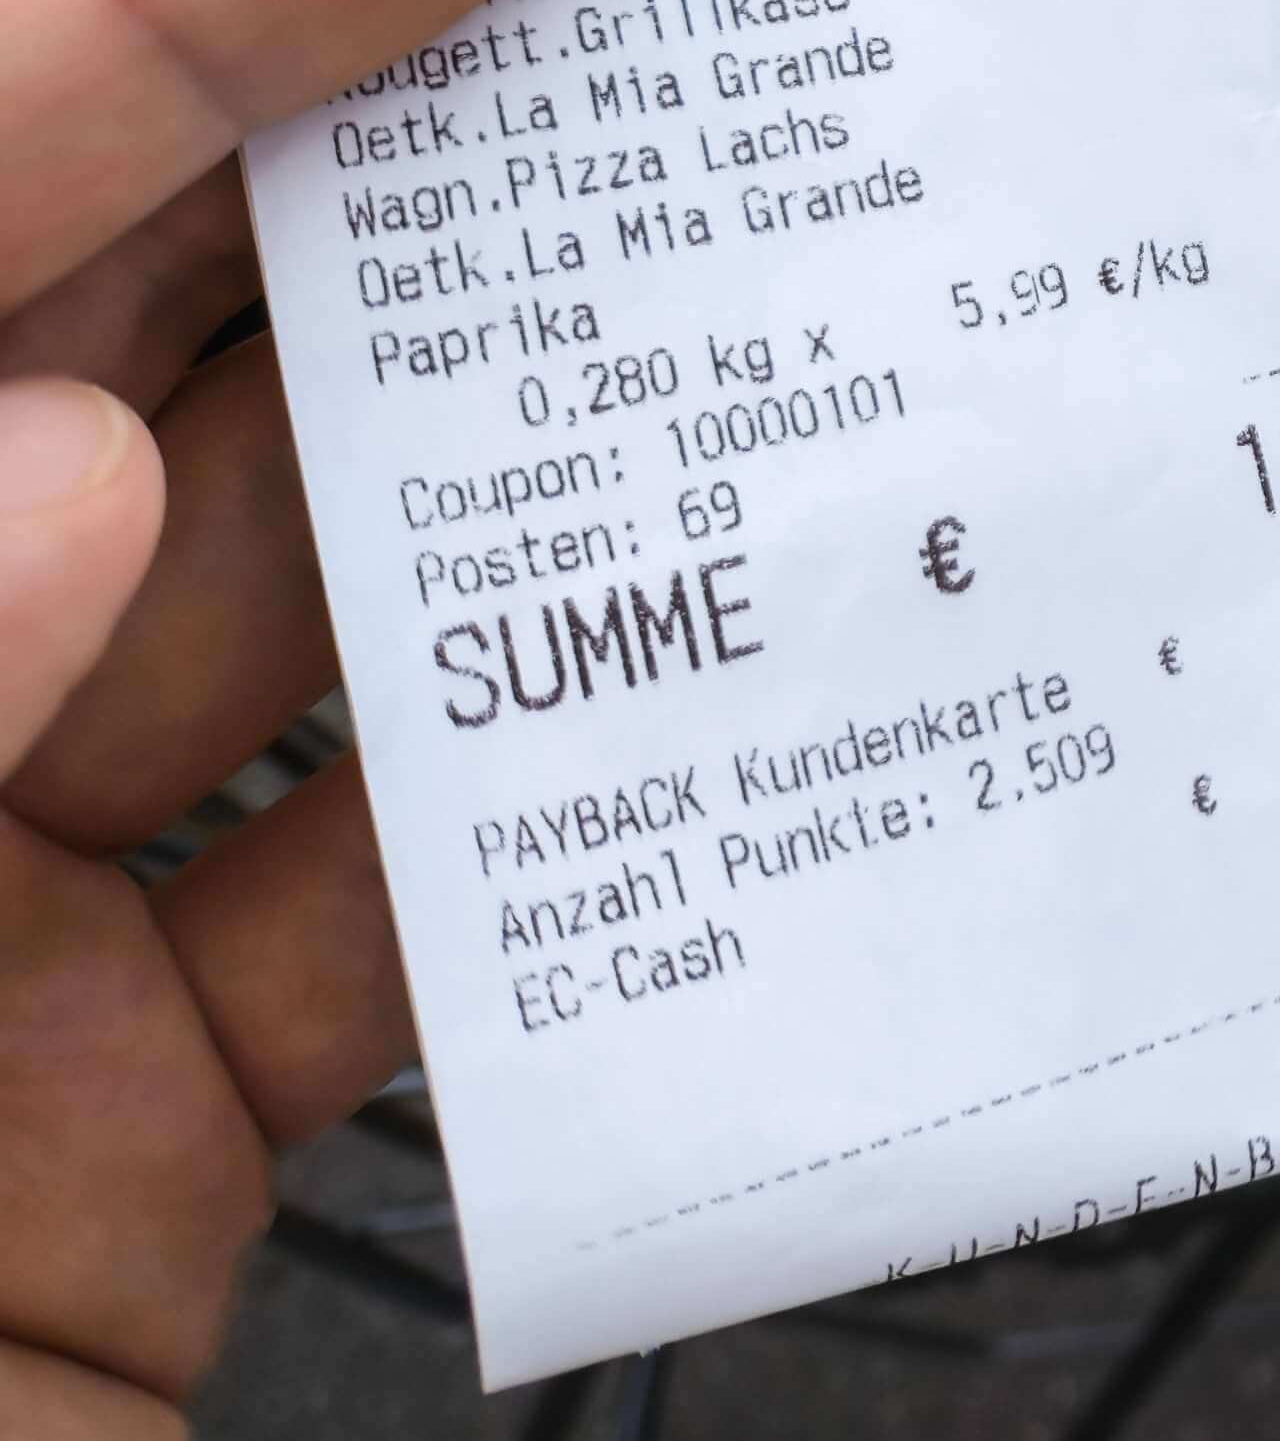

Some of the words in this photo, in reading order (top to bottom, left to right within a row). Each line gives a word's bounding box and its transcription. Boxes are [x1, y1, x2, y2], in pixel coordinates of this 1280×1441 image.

[333, 92, 559, 169] Oetk.La
[587, 66, 685, 123] Mia
[712, 27, 894, 100] Grande
[343, 145, 668, 240] Wagn.Pizza
[699, 109, 850, 172] Lachs
[357, 228, 585, 310] Oetk.La
[615, 202, 713, 260] Mia
[741, 158, 924, 235] Grande
[370, 298, 601, 386] Paprika
[518, 347, 679, 427] 0,280
[707, 334, 775, 387] kg
[951, 263, 1068, 329] 5,99
[1097, 239, 1209, 299] €/kg
[400, 447, 624, 531] Coupon:
[666, 368, 905, 468] 10000101
[415, 520, 640, 607] Posten:
[677, 480, 742, 541] 69
[433, 554, 765, 730] SUMME
[918, 515, 976, 596] €
[473, 765, 707, 878] PAYBACK
[734, 672, 1071, 806] Kundenkarte
[1157, 636, 1182, 676] €
[501, 849, 686, 955] Anzahl
[719, 793, 934, 889] Punkte:
[968, 723, 1115, 812] 2.509
[513, 918, 746, 1033] EC-Cash
[1192, 774, 1217, 817] €
